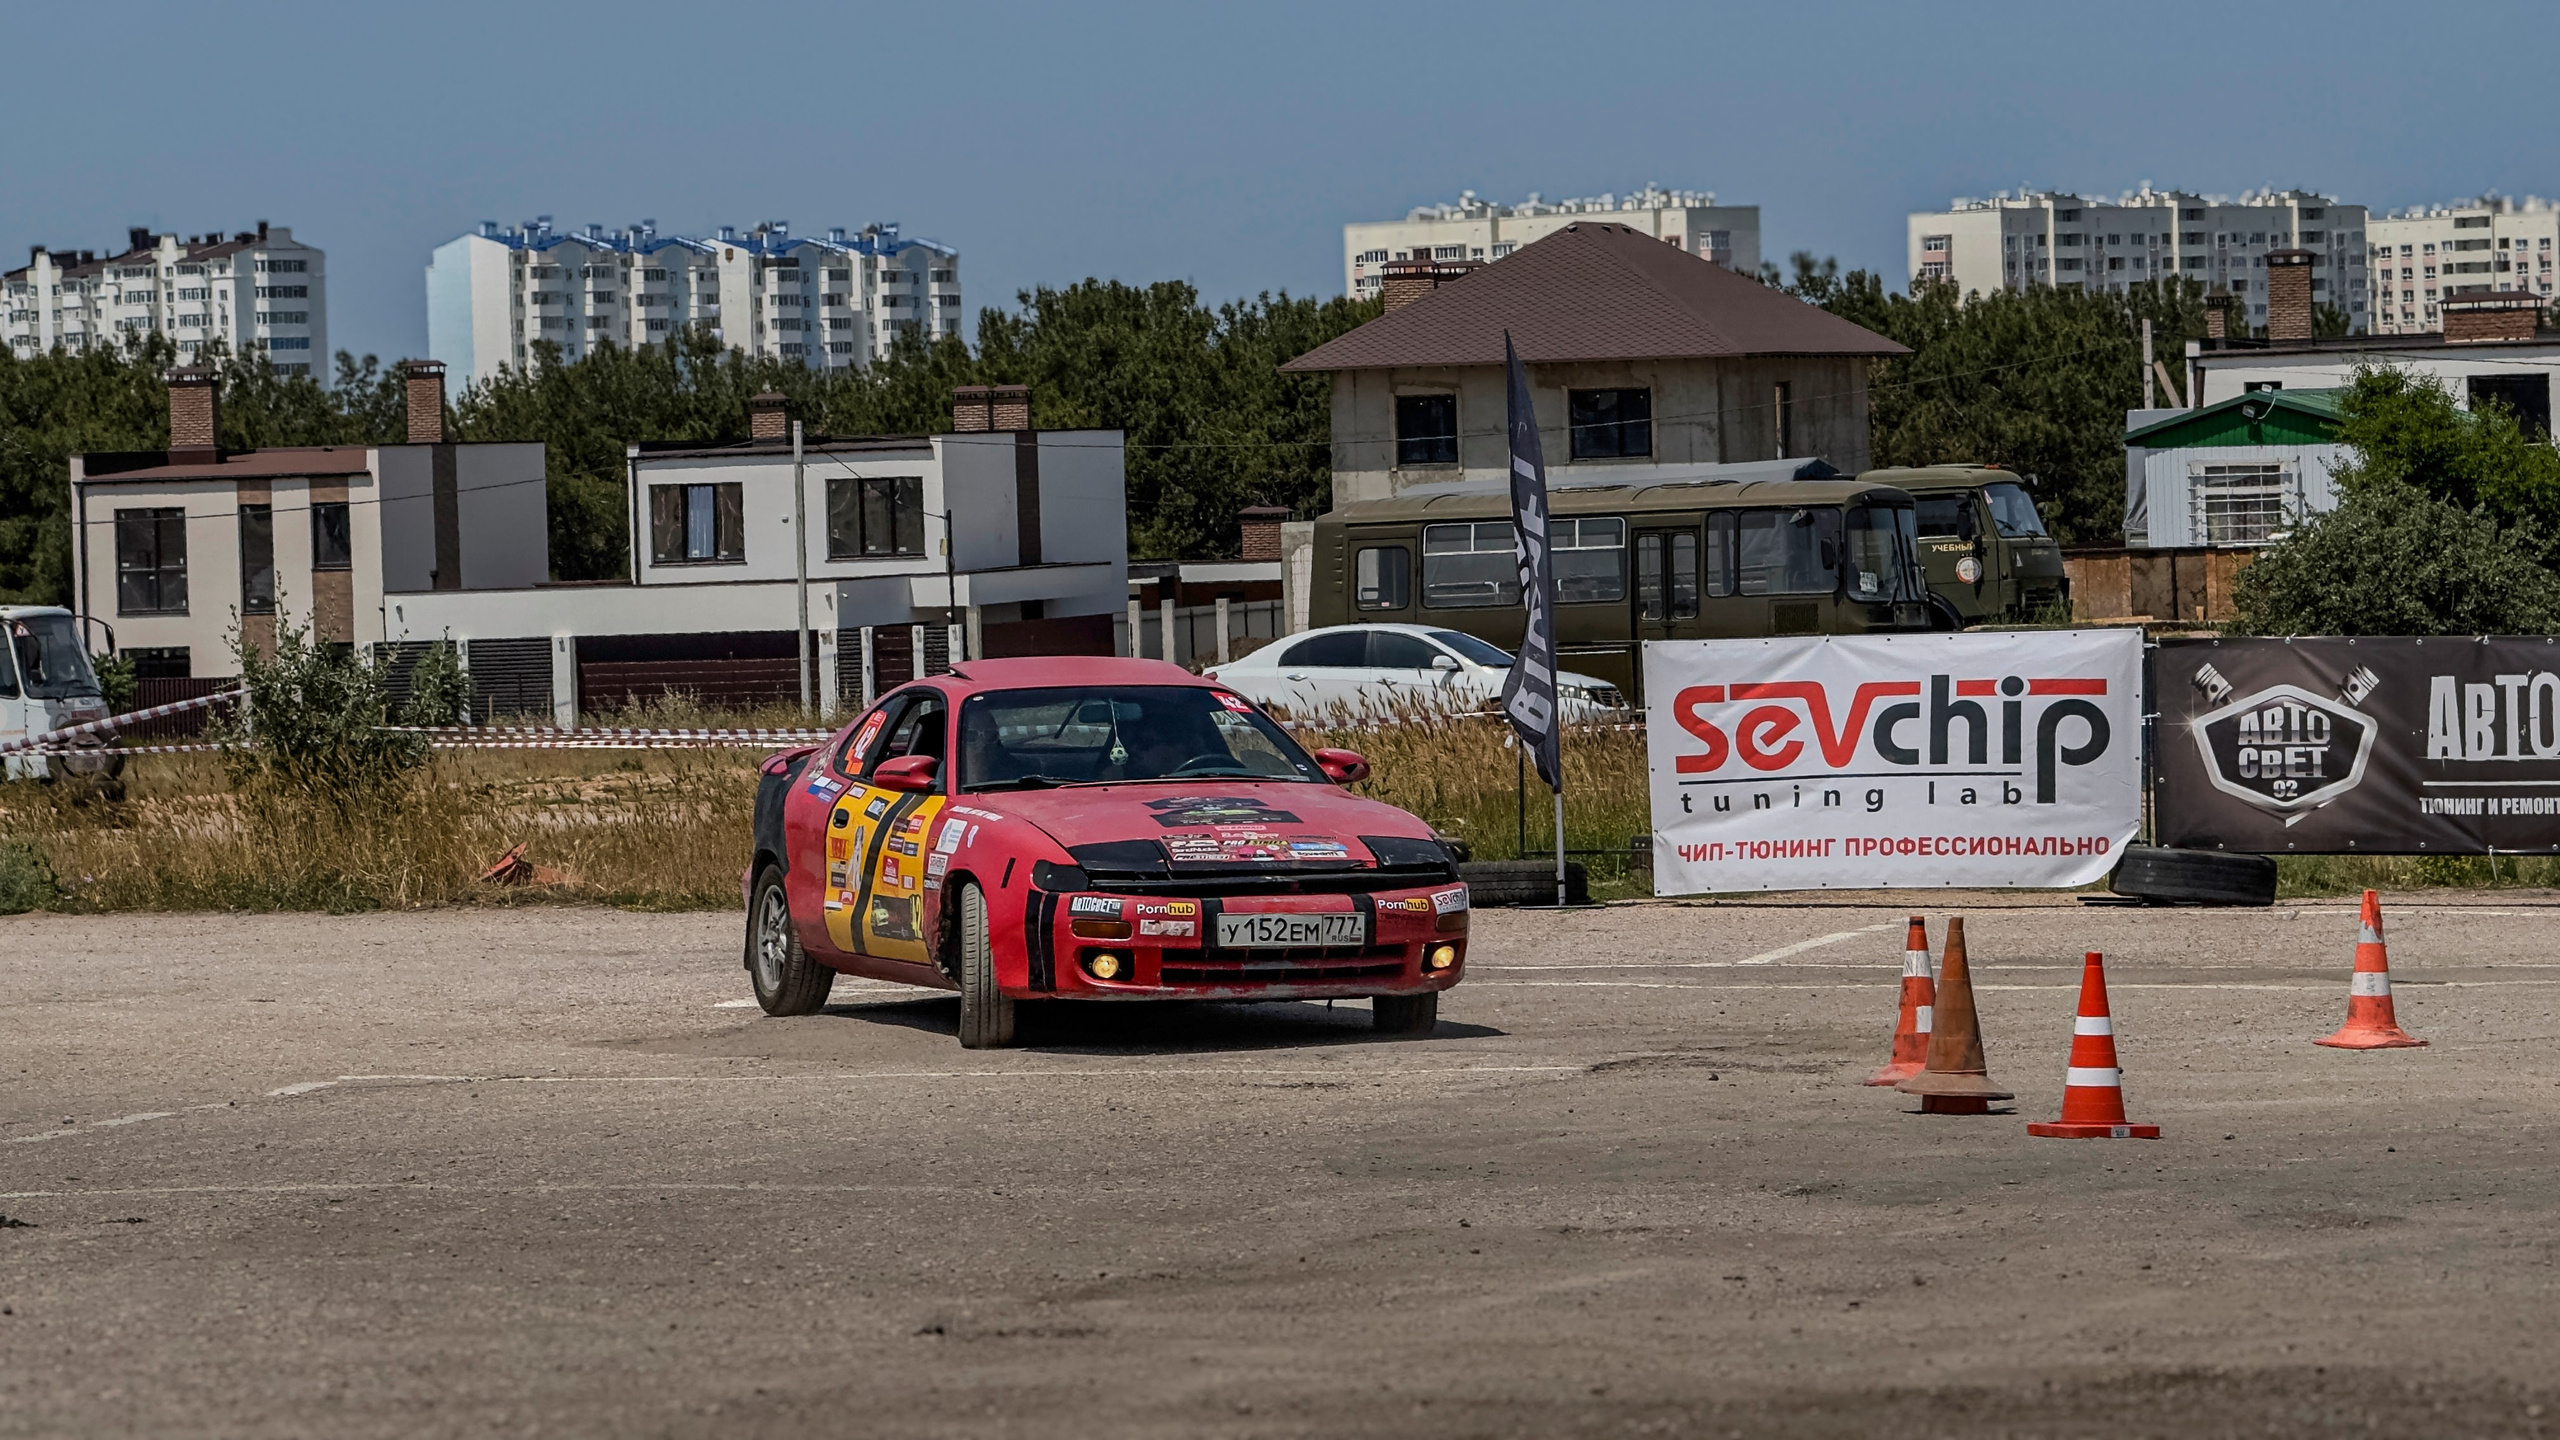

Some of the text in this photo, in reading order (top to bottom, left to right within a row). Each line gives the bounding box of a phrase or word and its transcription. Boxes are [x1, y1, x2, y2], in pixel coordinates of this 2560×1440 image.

[1931, 540, 1974, 552] УЧЕБНЫЙ
[1217, 695, 1248, 710] 42
[2238, 701, 2331, 745] АВТО
[2238, 746, 2329, 779] СВЕТ
[1680, 781, 2023, 813] tuning lab
[2273, 780, 2298, 798] 92
[2419, 797, 2485, 815] ТЮНИНГ
[2488, 797, 2498, 815] И
[1677, 836, 2110, 862] ЧИП-ТЮНИНГ ПРОФЕССИОНАЛЬНО
[1137, 902, 1196, 916] Pornhub
[1377, 898, 1430, 912] Pornhub
[1324, 916, 1358, 935] 777
